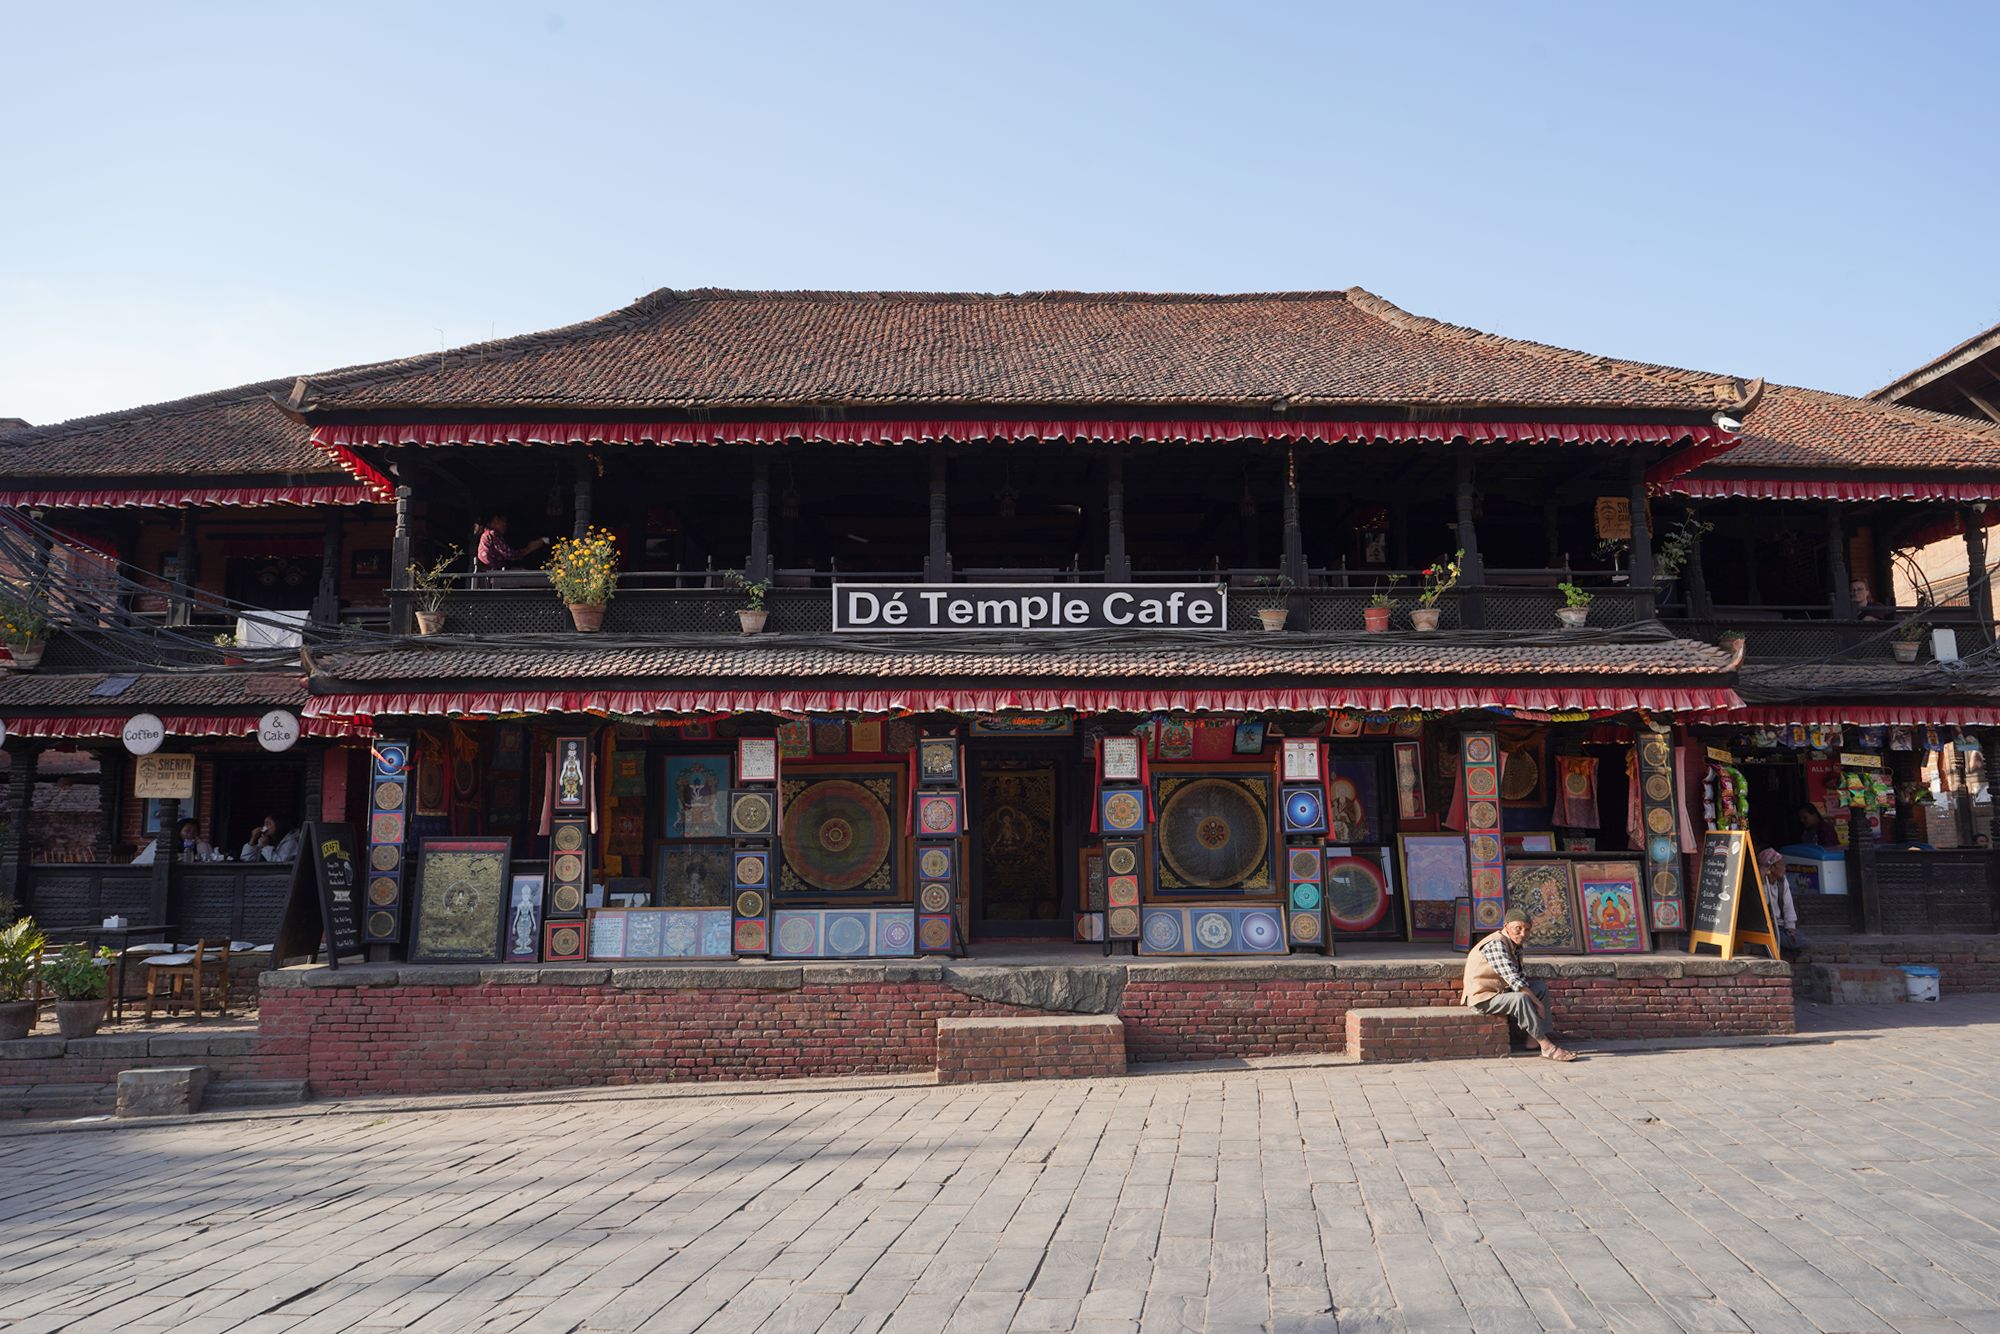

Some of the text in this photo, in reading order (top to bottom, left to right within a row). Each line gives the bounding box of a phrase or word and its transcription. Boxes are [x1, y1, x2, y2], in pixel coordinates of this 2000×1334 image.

[848, 591, 1214, 628] Dé Temple Cafe
[272, 716, 283, 728] &
[124, 729, 160, 741] Coffee
[263, 730, 291, 742] Cake
[158, 758, 192, 771] SHERPA
